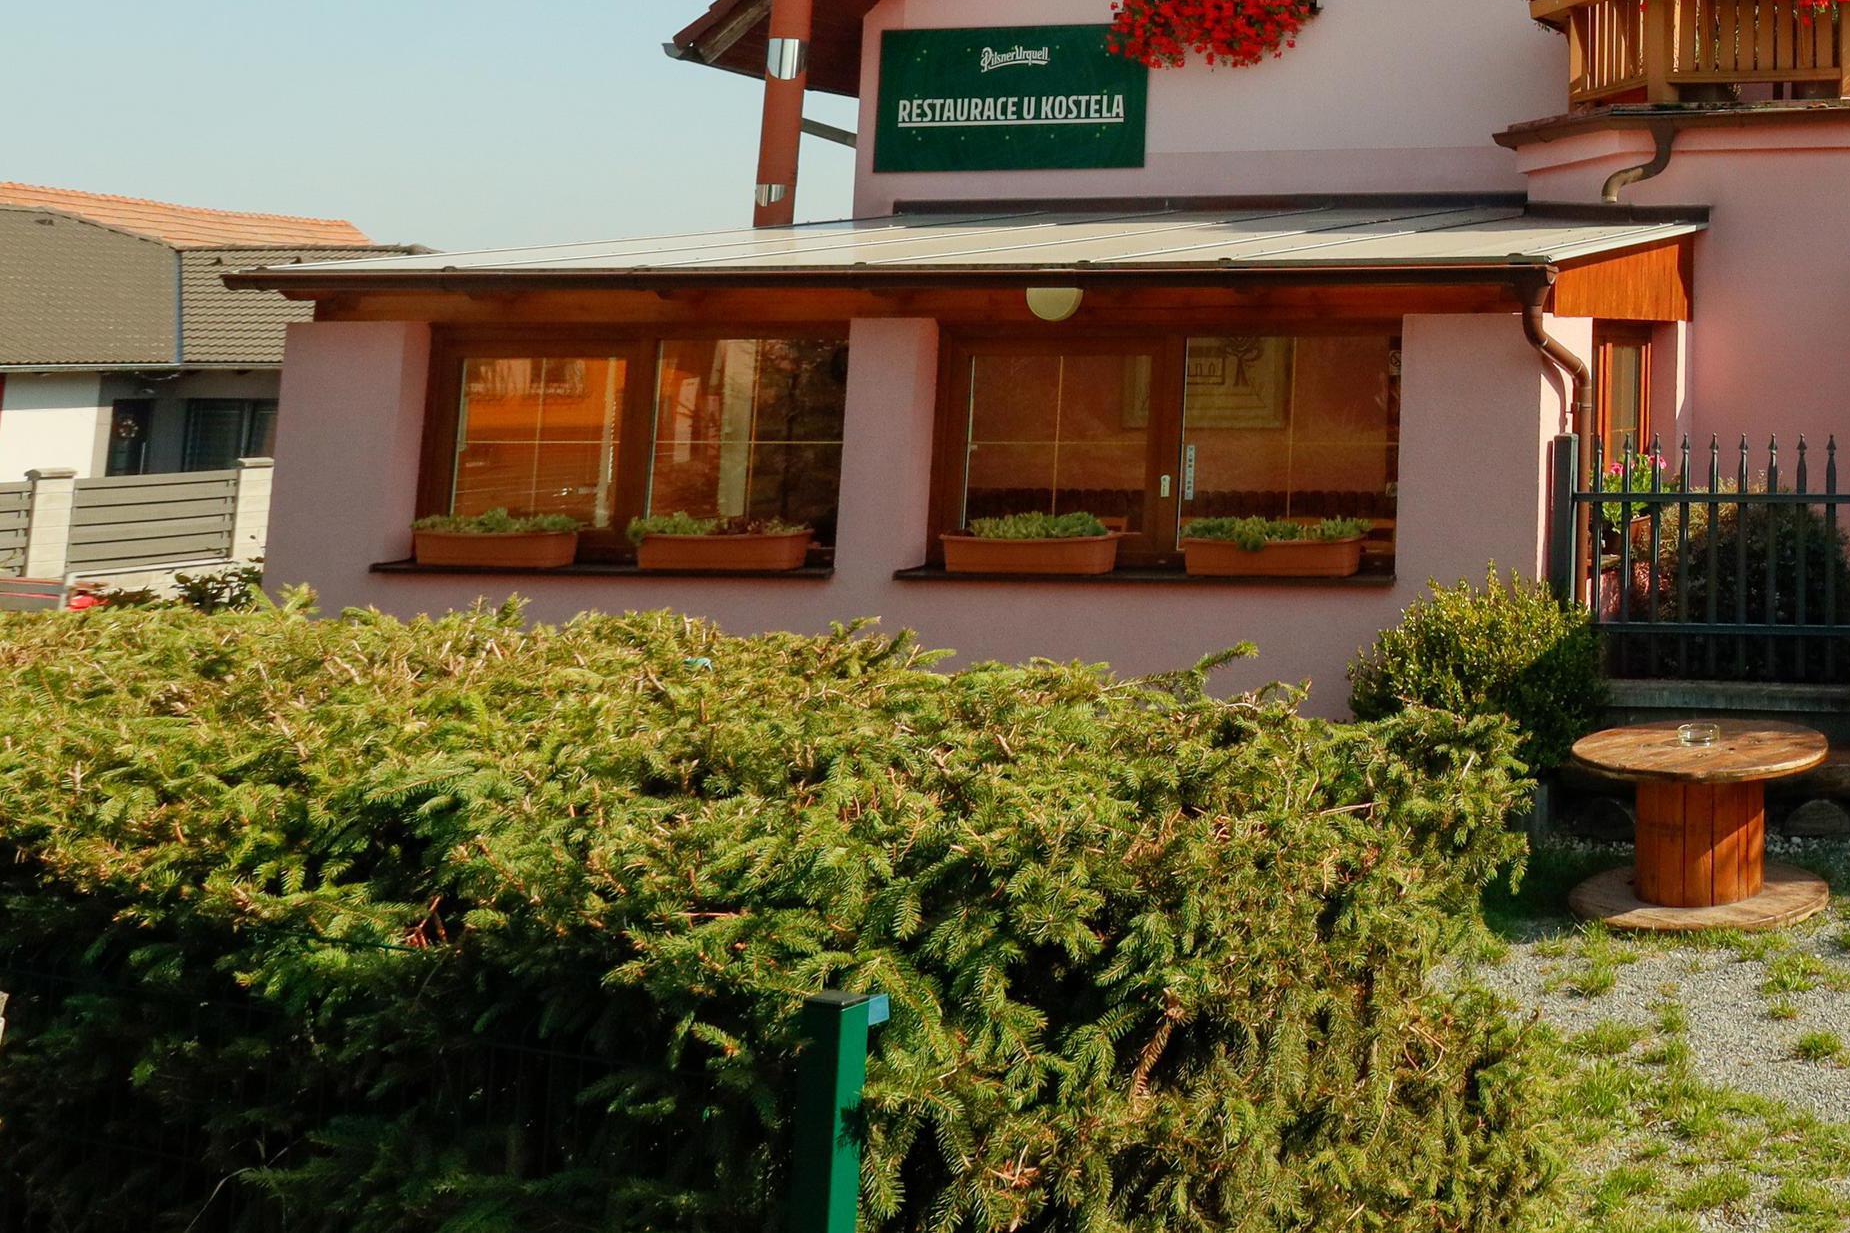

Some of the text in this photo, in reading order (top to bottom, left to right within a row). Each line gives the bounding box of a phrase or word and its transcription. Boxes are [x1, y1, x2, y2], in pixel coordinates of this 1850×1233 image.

[980, 45, 1048, 73] Pilsner Urquell
[898, 94, 1124, 122] RESTAURACE U KOSTELA
